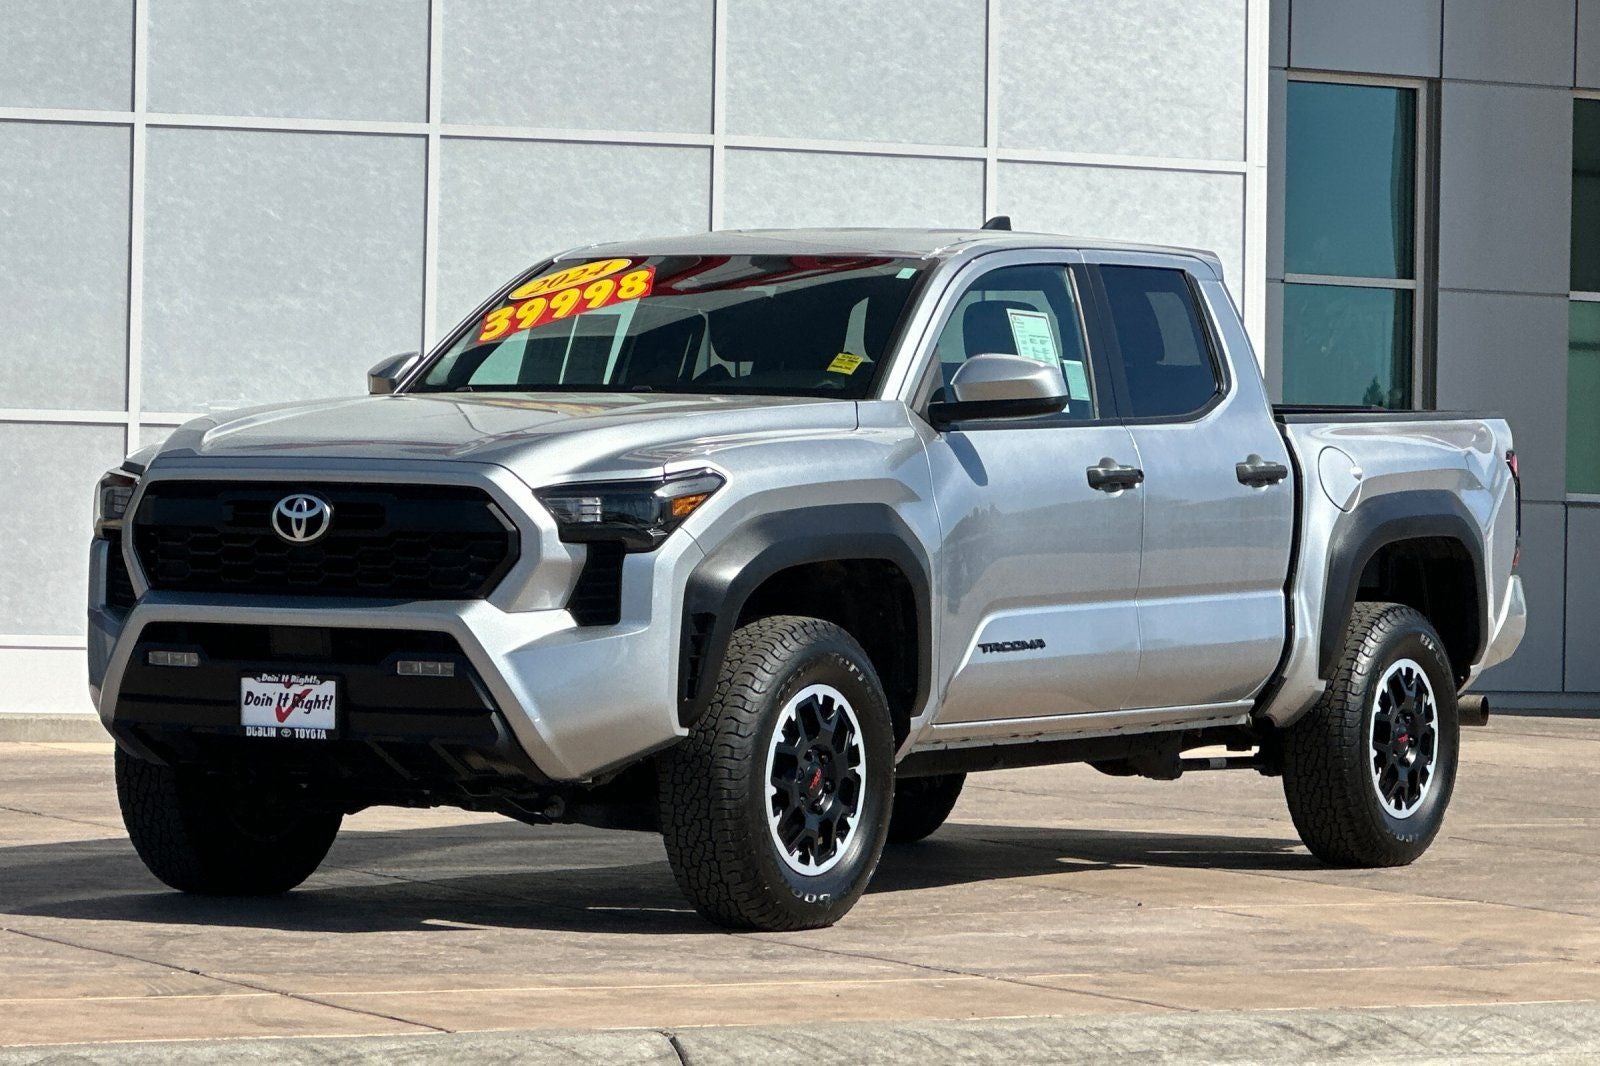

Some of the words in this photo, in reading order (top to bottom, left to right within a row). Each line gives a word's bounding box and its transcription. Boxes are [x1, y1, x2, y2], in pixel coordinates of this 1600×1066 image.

[526, 261, 613, 295] 2024
[479, 270, 653, 342] 39998
[977, 638, 1047, 654] TACOMA
[261, 673, 281, 682] Doin'
[290, 675, 318, 686] Right!
[243, 690, 277, 707] Doin'
[277, 692, 291, 708] It
[291, 693, 335, 715] Right!
[246, 726, 277, 738] DUBLIN
[294, 728, 328, 740] TOYOTA
